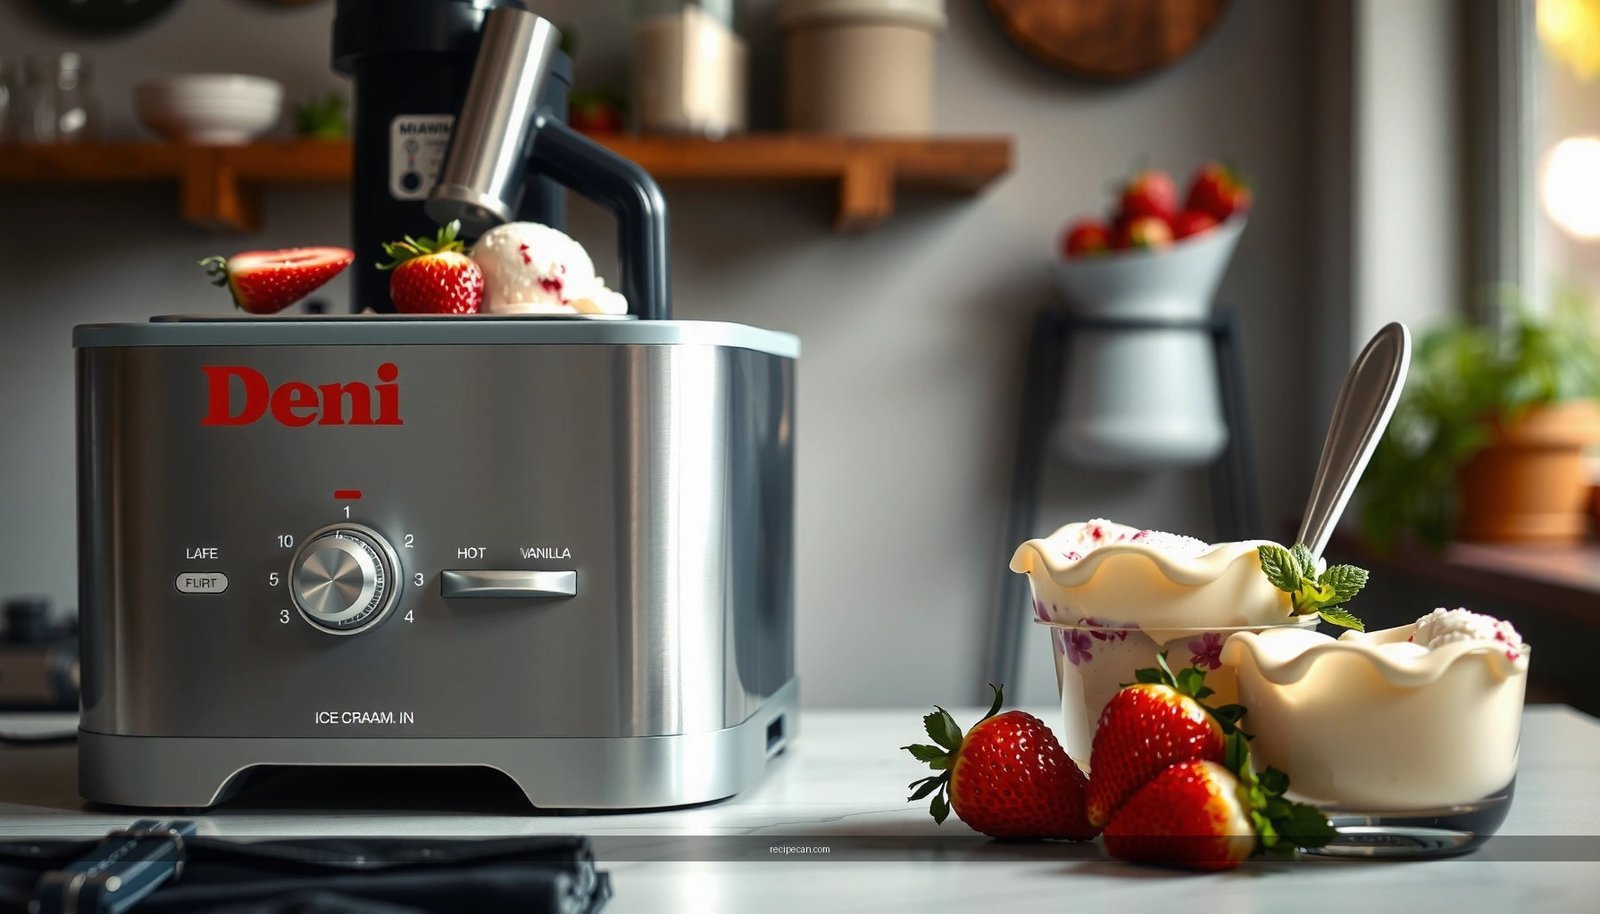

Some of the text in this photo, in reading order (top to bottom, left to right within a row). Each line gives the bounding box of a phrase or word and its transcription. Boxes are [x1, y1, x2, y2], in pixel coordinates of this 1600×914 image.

[200, 362, 404, 427] Deni
[343, 506, 351, 519] 1
[277, 535, 294, 548] 10
[404, 534, 414, 548] 2
[186, 547, 219, 560] LAFE
[457, 547, 572, 559] HOT VANILLA
[269, 572, 279, 587] 5
[414, 572, 424, 587] 3
[279, 609, 290, 624] 3
[404, 610, 415, 623] 4
[315, 711, 414, 724] ICE CRAAM. IN
